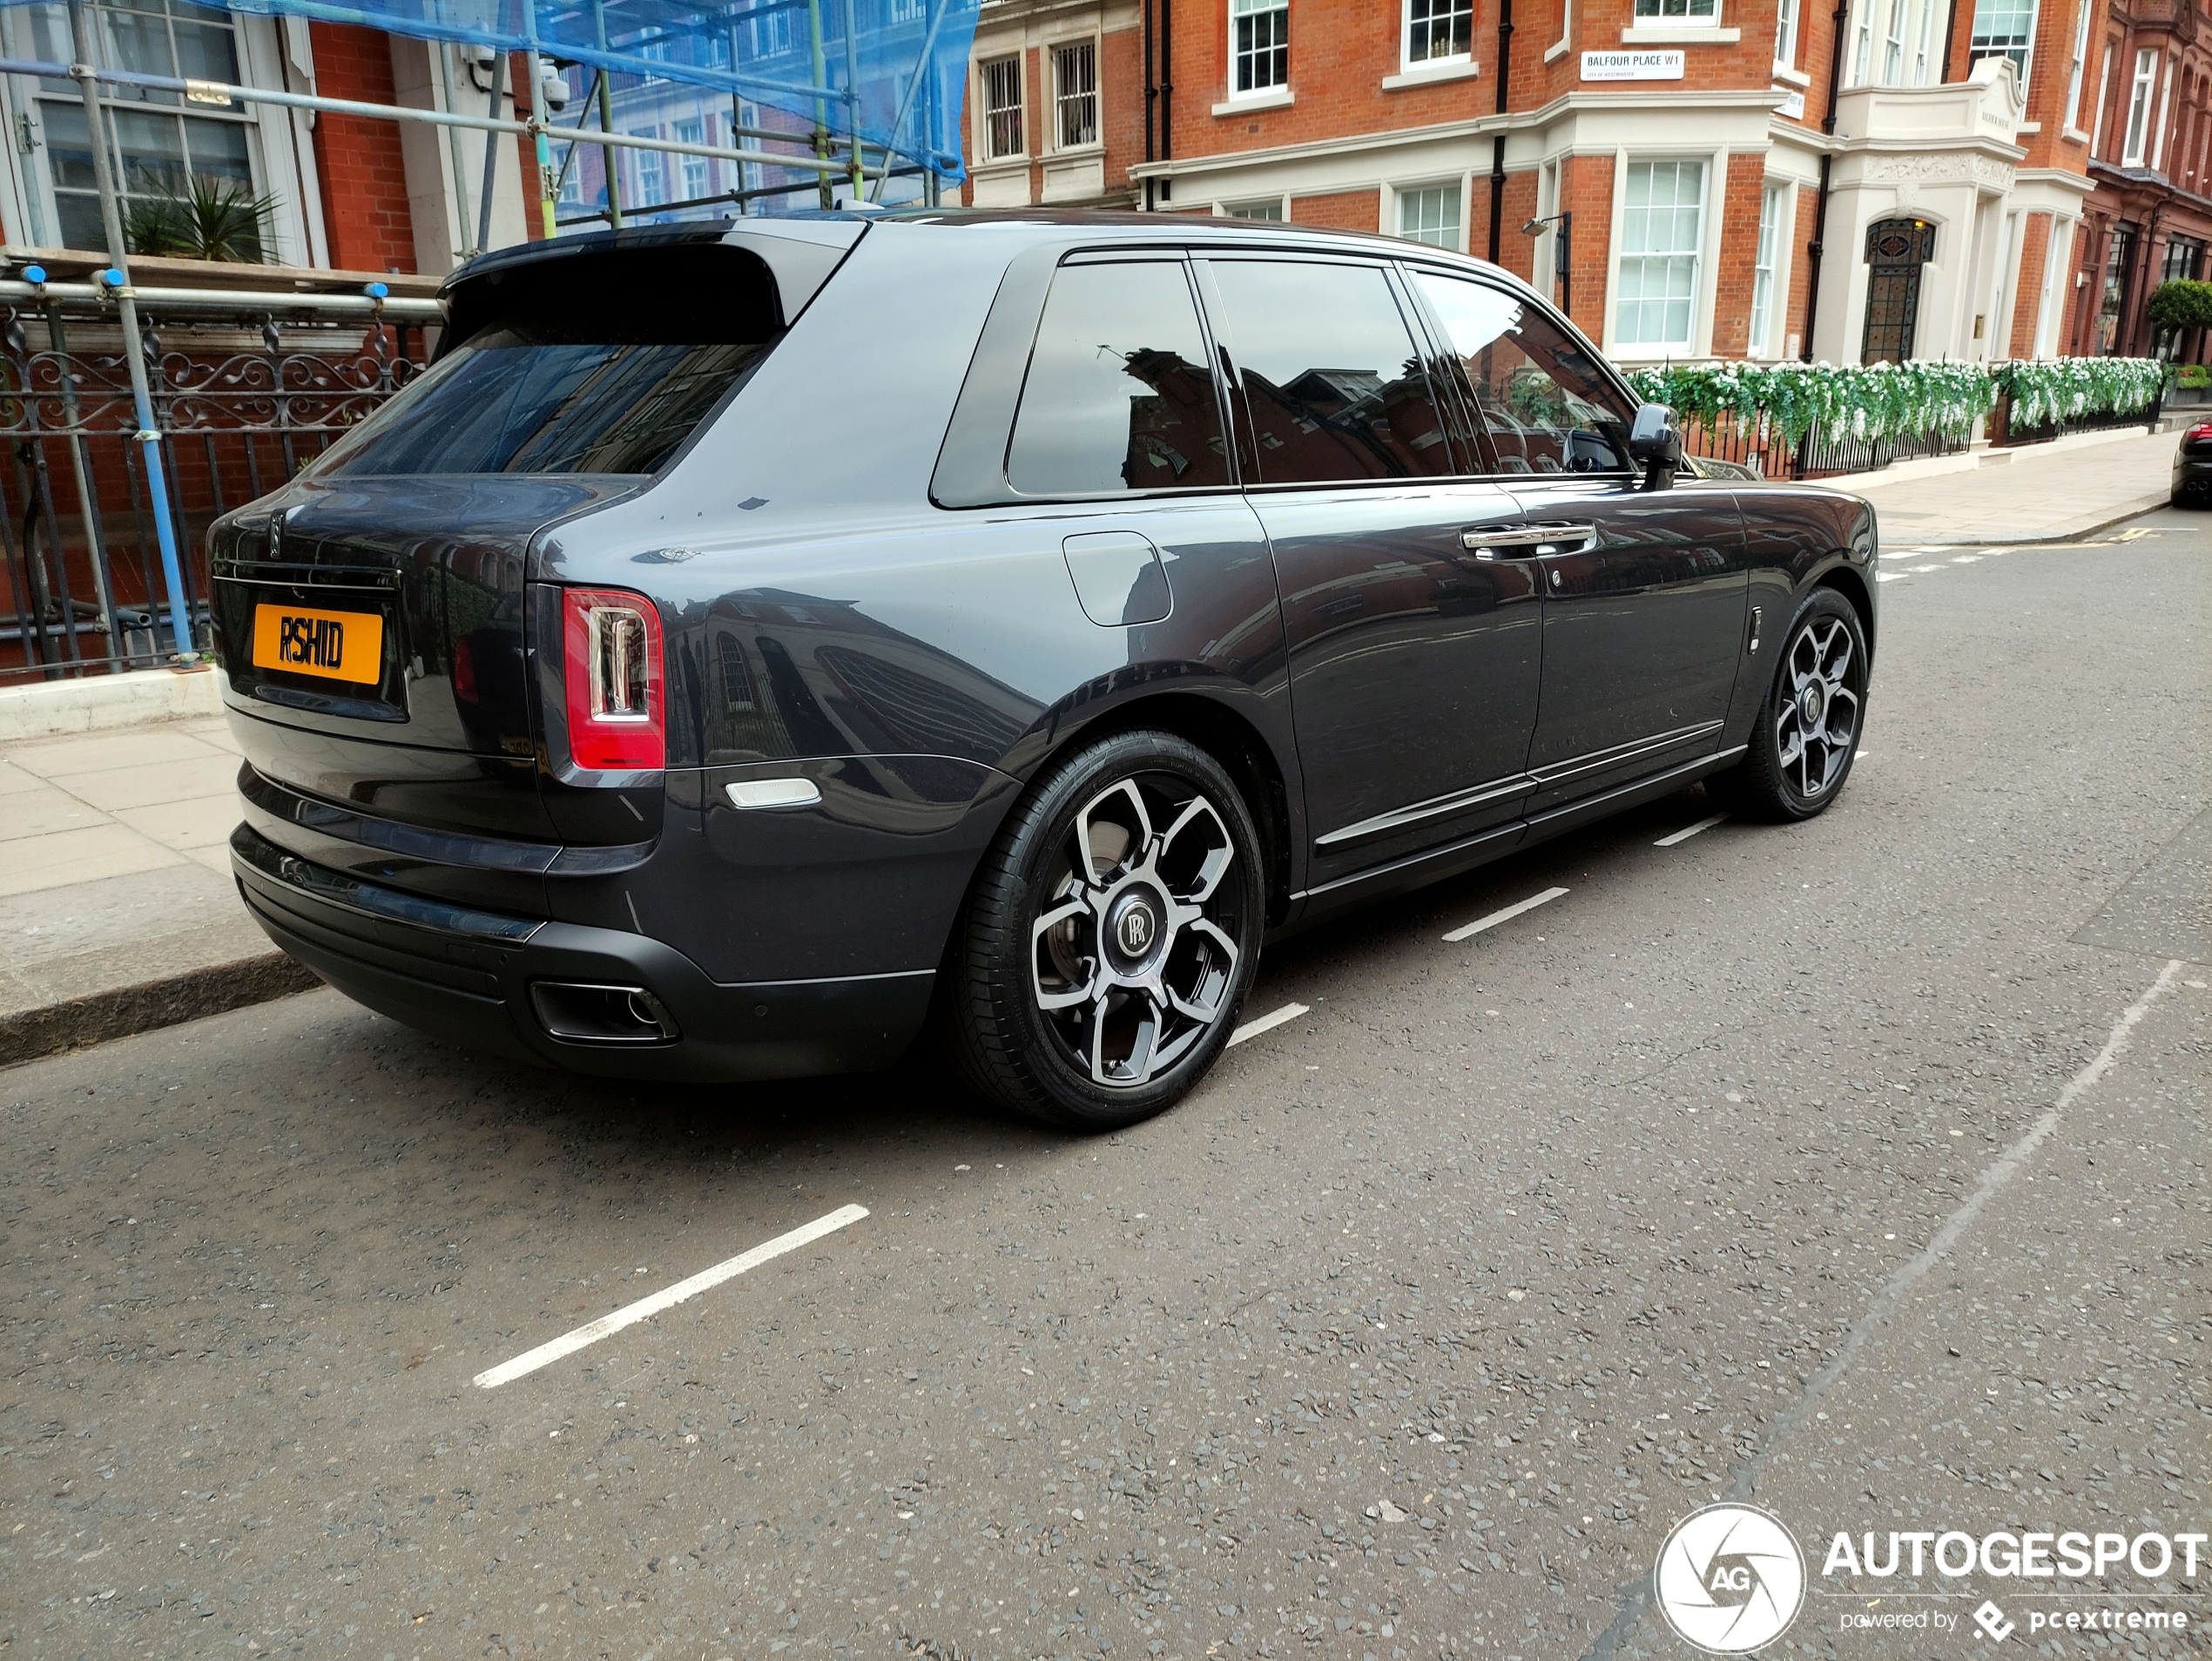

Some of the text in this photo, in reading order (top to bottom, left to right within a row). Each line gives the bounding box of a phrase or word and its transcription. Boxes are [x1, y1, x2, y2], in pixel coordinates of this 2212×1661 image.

[1588, 55, 1679, 66] BALFOUR PLACE W1
